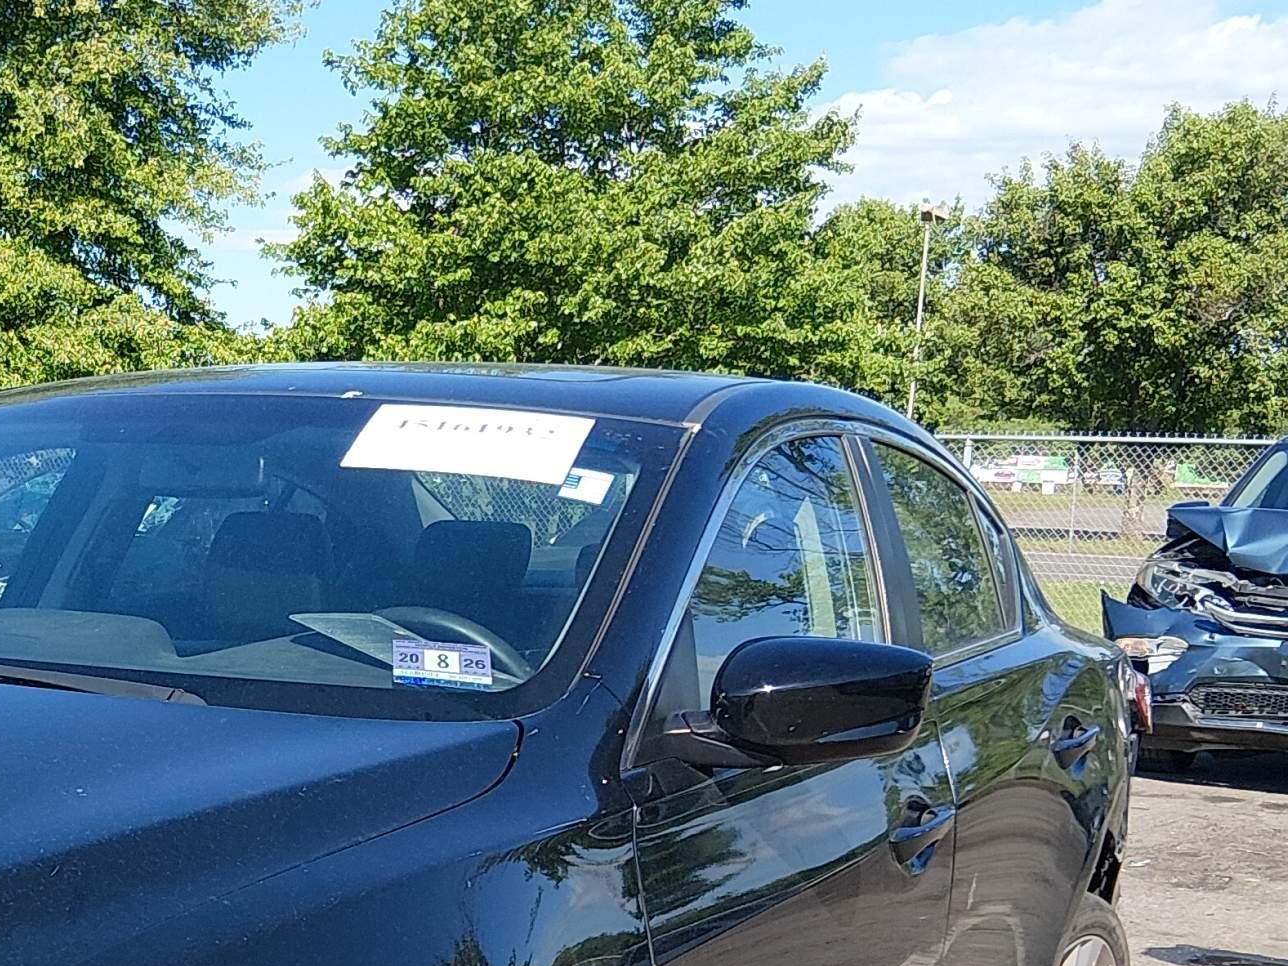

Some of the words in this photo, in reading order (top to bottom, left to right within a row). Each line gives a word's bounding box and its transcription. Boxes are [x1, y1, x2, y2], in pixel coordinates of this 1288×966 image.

[399, 653, 419, 663] 20
[437, 653, 450, 669] 8
[463, 658, 486, 670] 26
